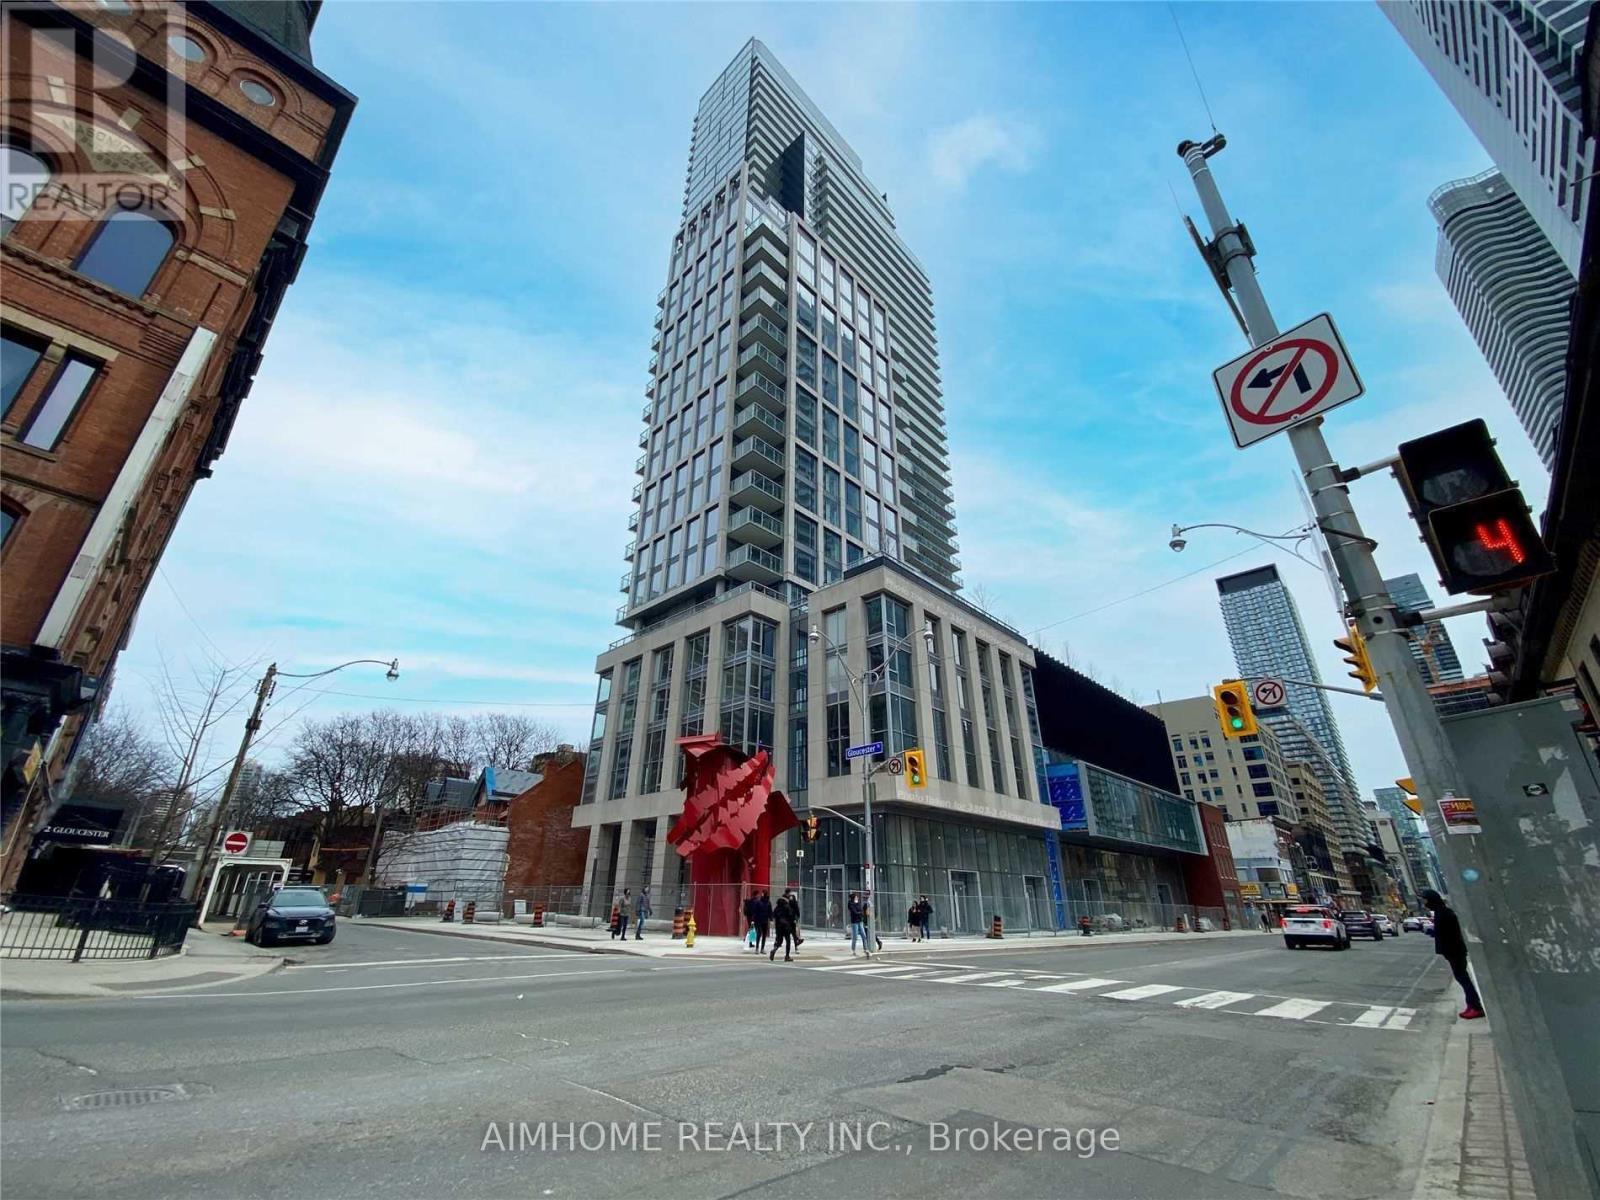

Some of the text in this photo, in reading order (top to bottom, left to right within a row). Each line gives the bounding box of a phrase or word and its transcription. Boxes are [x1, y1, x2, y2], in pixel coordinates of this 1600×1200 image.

[1475, 518, 1524, 564] 4
[847, 745, 876, 758] Gloucester
[53, 826, 110, 838] GLOUCESTER
